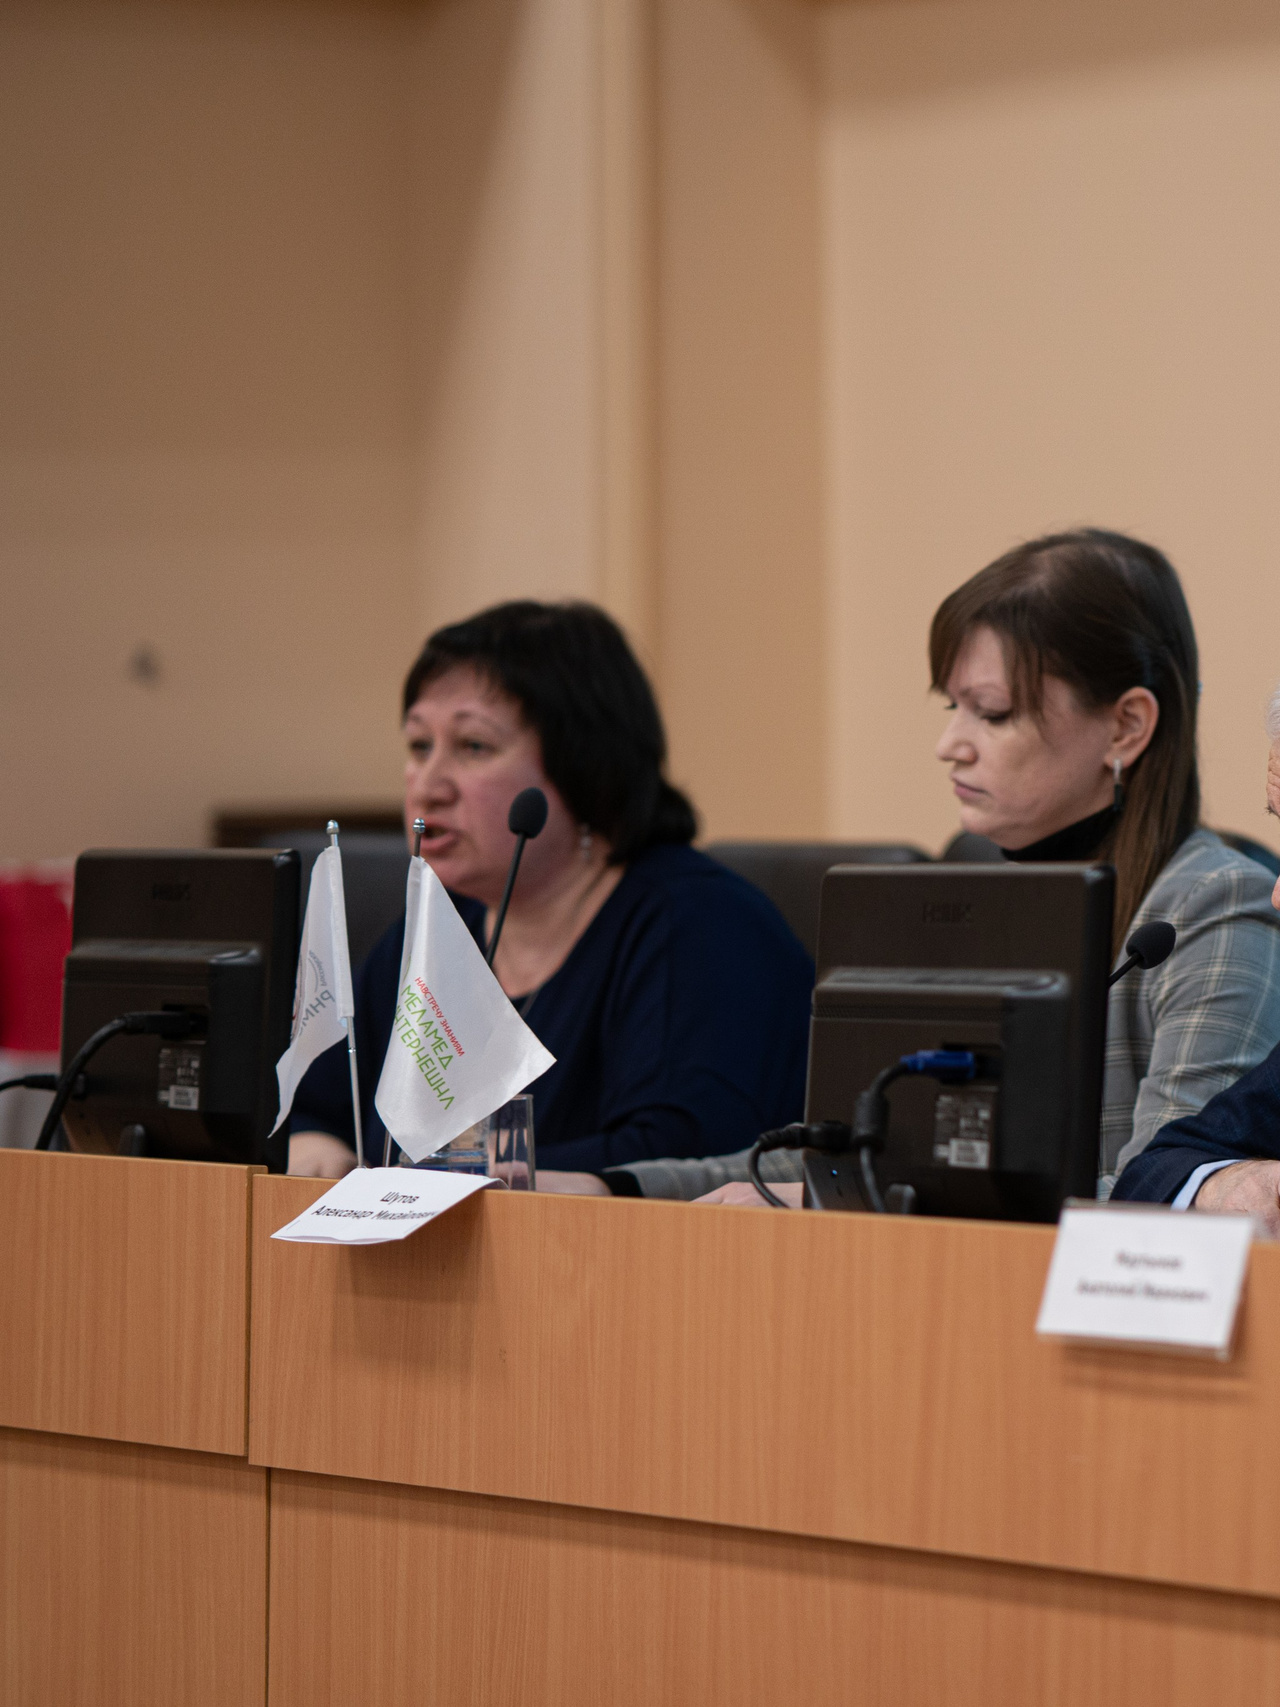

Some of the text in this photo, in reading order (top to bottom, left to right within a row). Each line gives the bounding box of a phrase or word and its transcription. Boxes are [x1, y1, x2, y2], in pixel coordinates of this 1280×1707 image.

[400, 984, 454, 1071] МЕЛАМЕД
[414, 976, 465, 1057] НАВСТРЕЧУ ЗНАНИЯМ
[394, 1004, 455, 1111] НТЕРНЕШНЛ
[311, 1204, 375, 1220] Александр
[380, 1191, 420, 1206] Шутов
